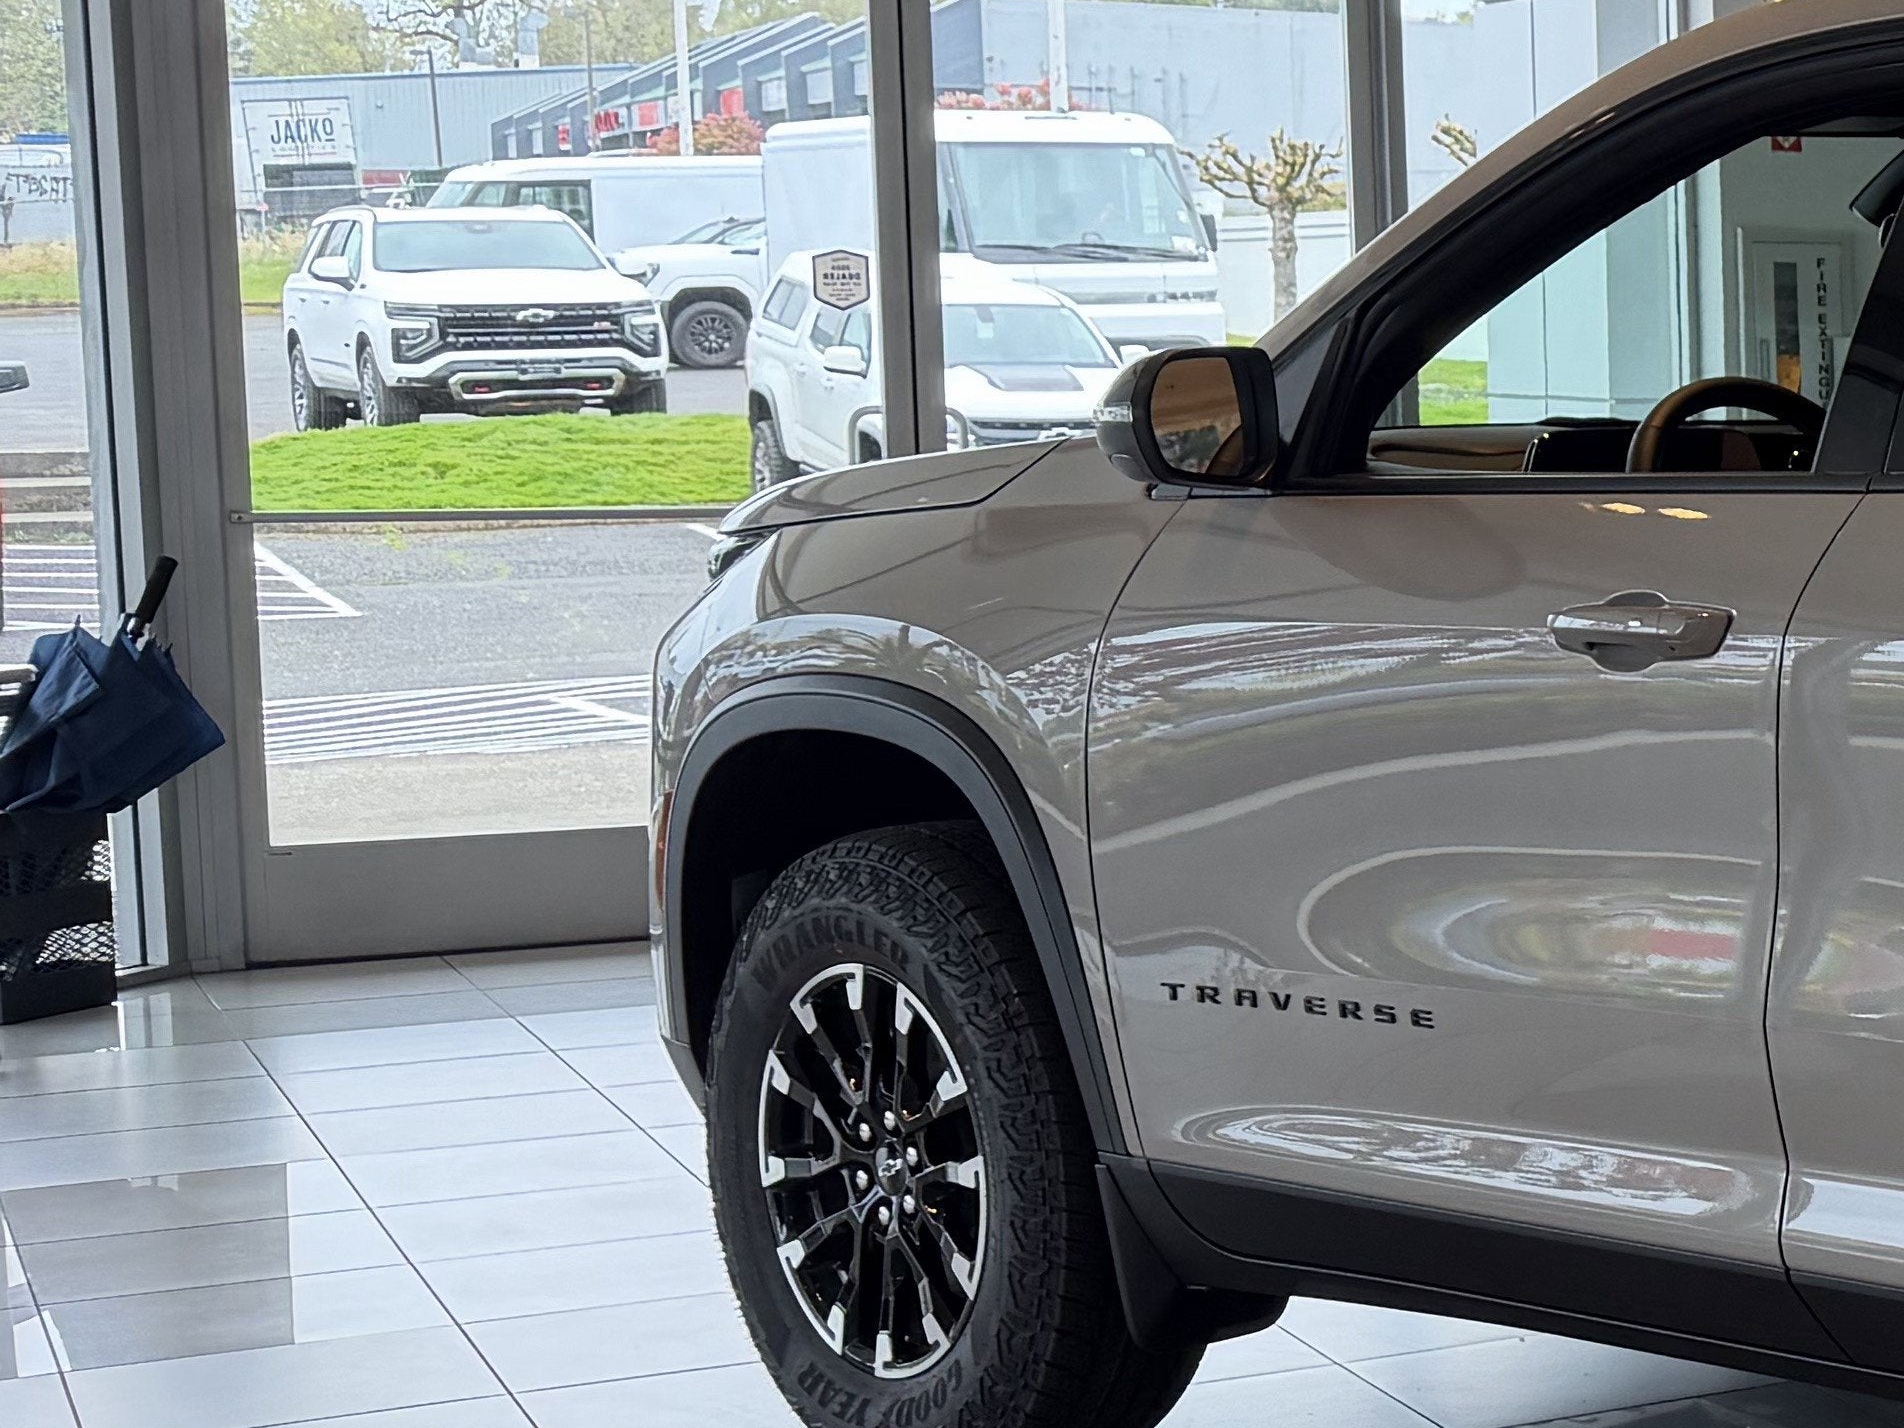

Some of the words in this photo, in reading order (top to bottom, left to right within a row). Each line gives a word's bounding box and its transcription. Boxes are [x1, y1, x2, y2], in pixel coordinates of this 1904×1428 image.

[270, 117, 335, 144] JACKO
[1816, 257, 1827, 307] FIRE
[1818, 313, 1830, 401] EXTINGU
[1160, 982, 1435, 1029] TRAVERSE
